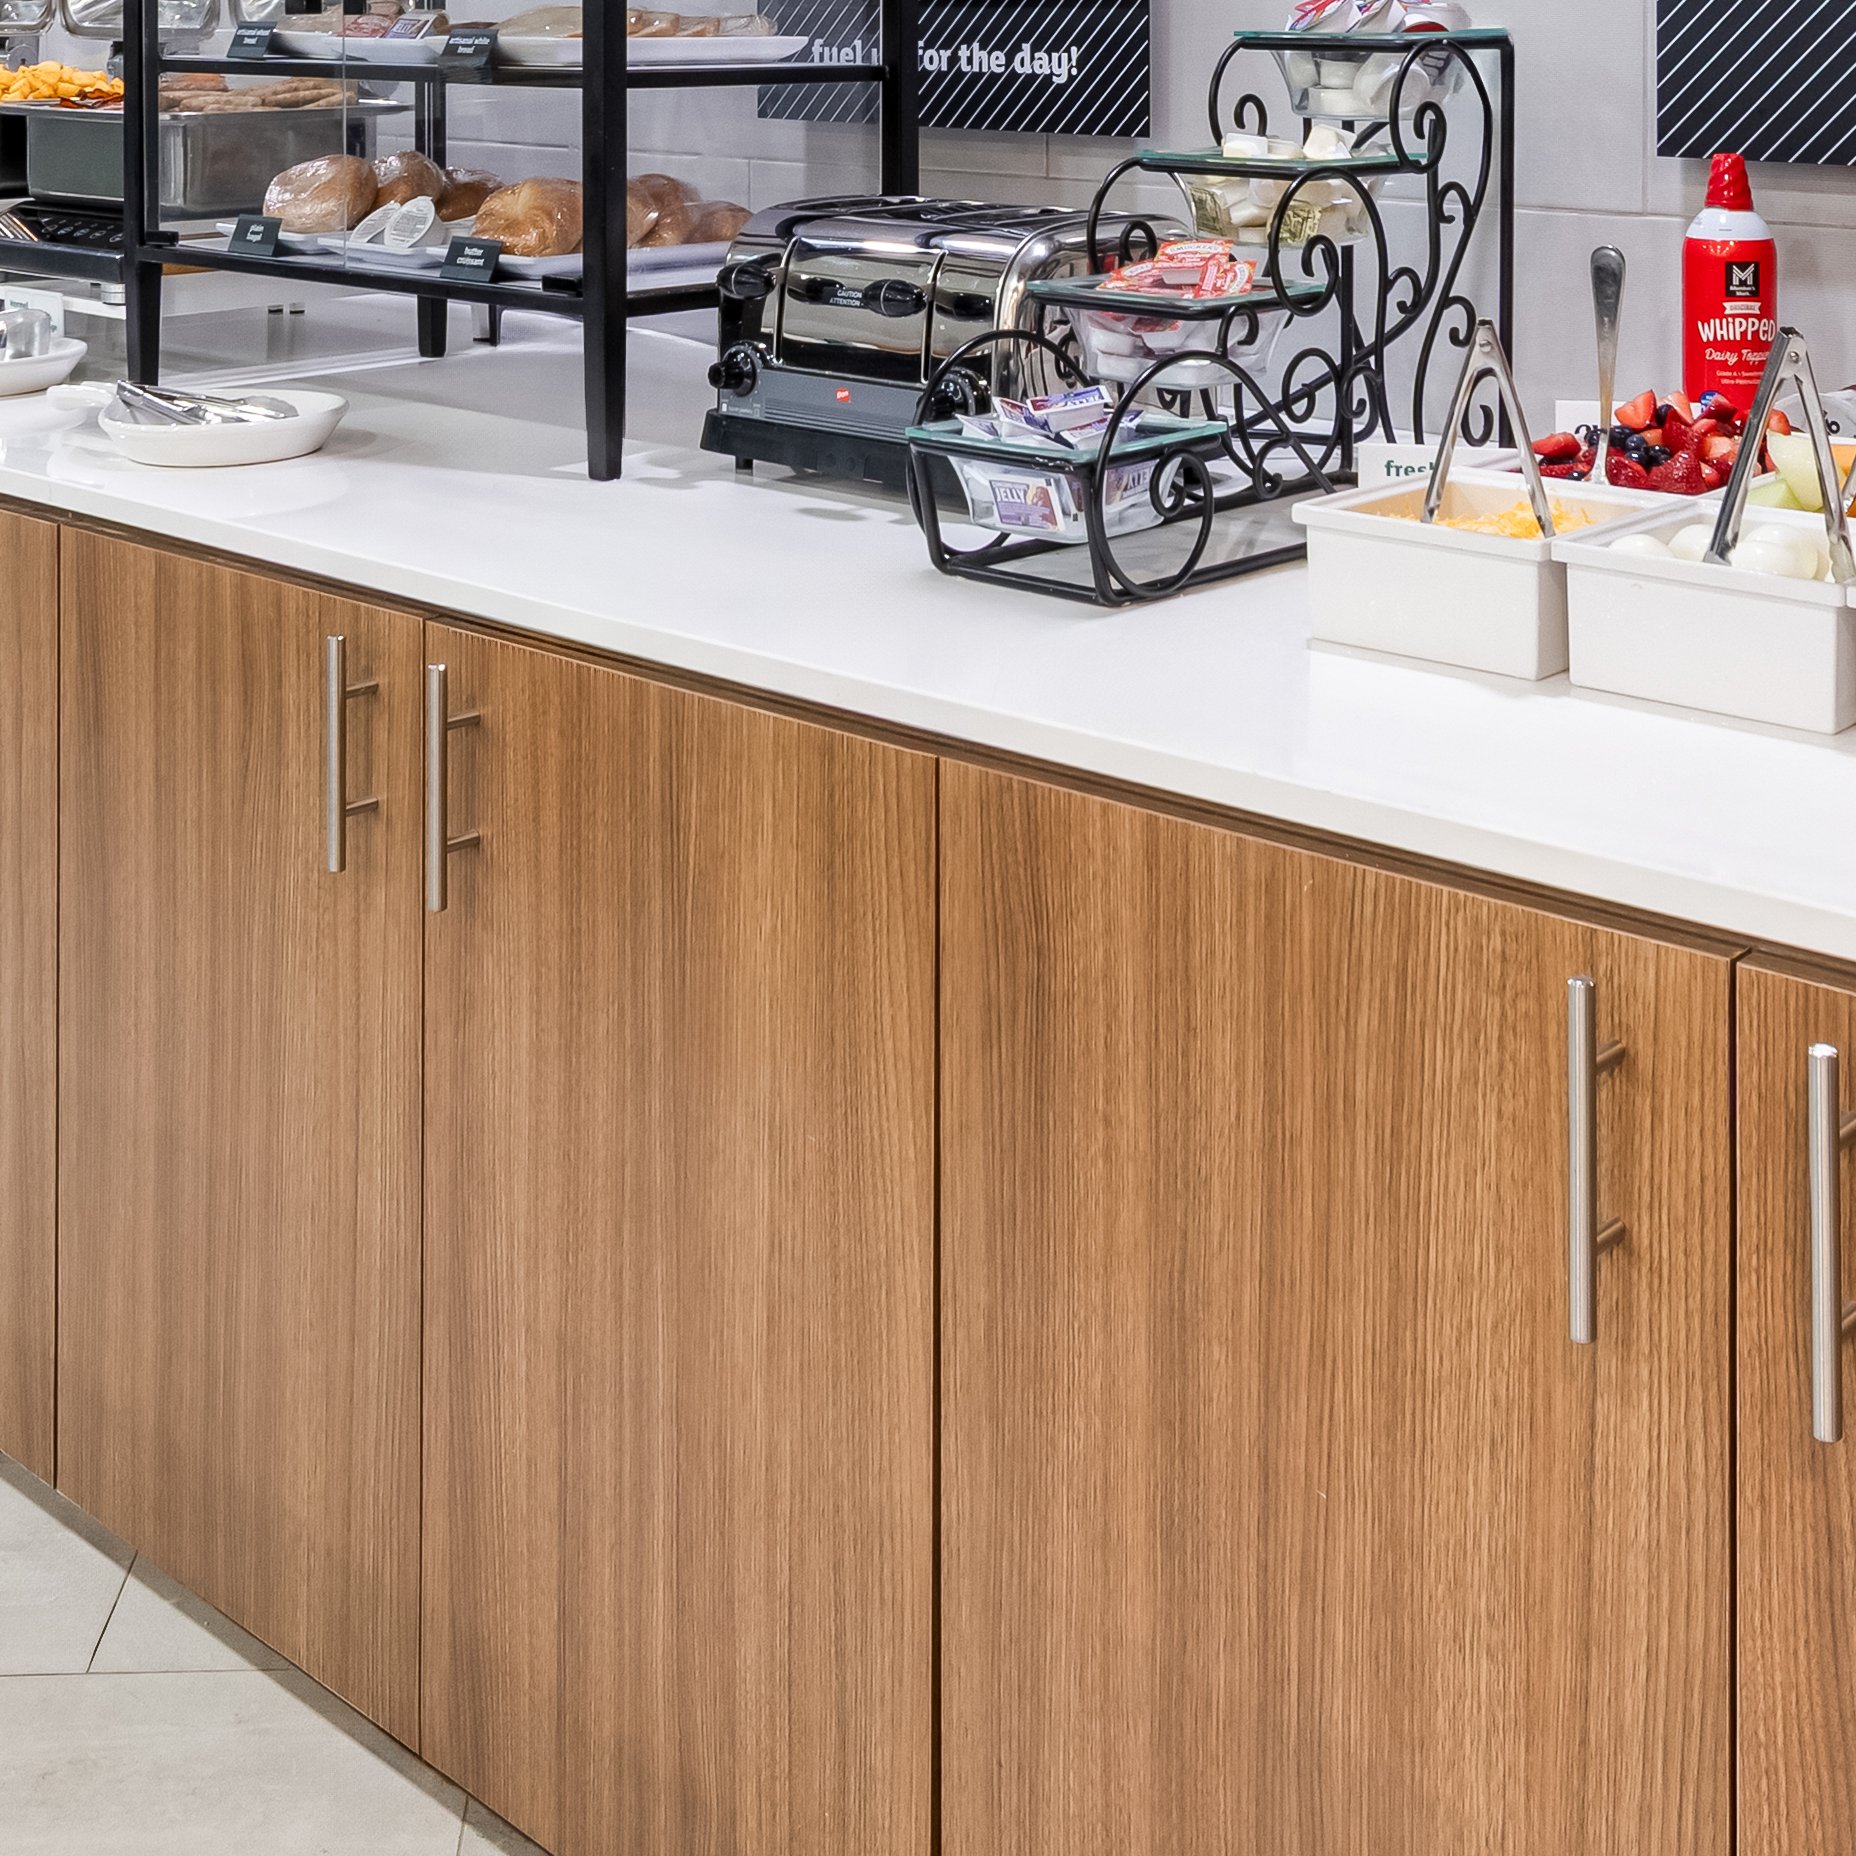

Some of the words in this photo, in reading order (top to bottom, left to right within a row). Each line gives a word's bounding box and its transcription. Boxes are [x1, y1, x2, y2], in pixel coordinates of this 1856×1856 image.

[811, 39, 862, 65] fuel
[958, 42, 1006, 72] the
[1014, 43, 1079, 84] day!
[836, 289, 863, 299] CAUTION
[1705, 347, 1739, 366] Dairy
[996, 486, 1026, 503] JELLY
